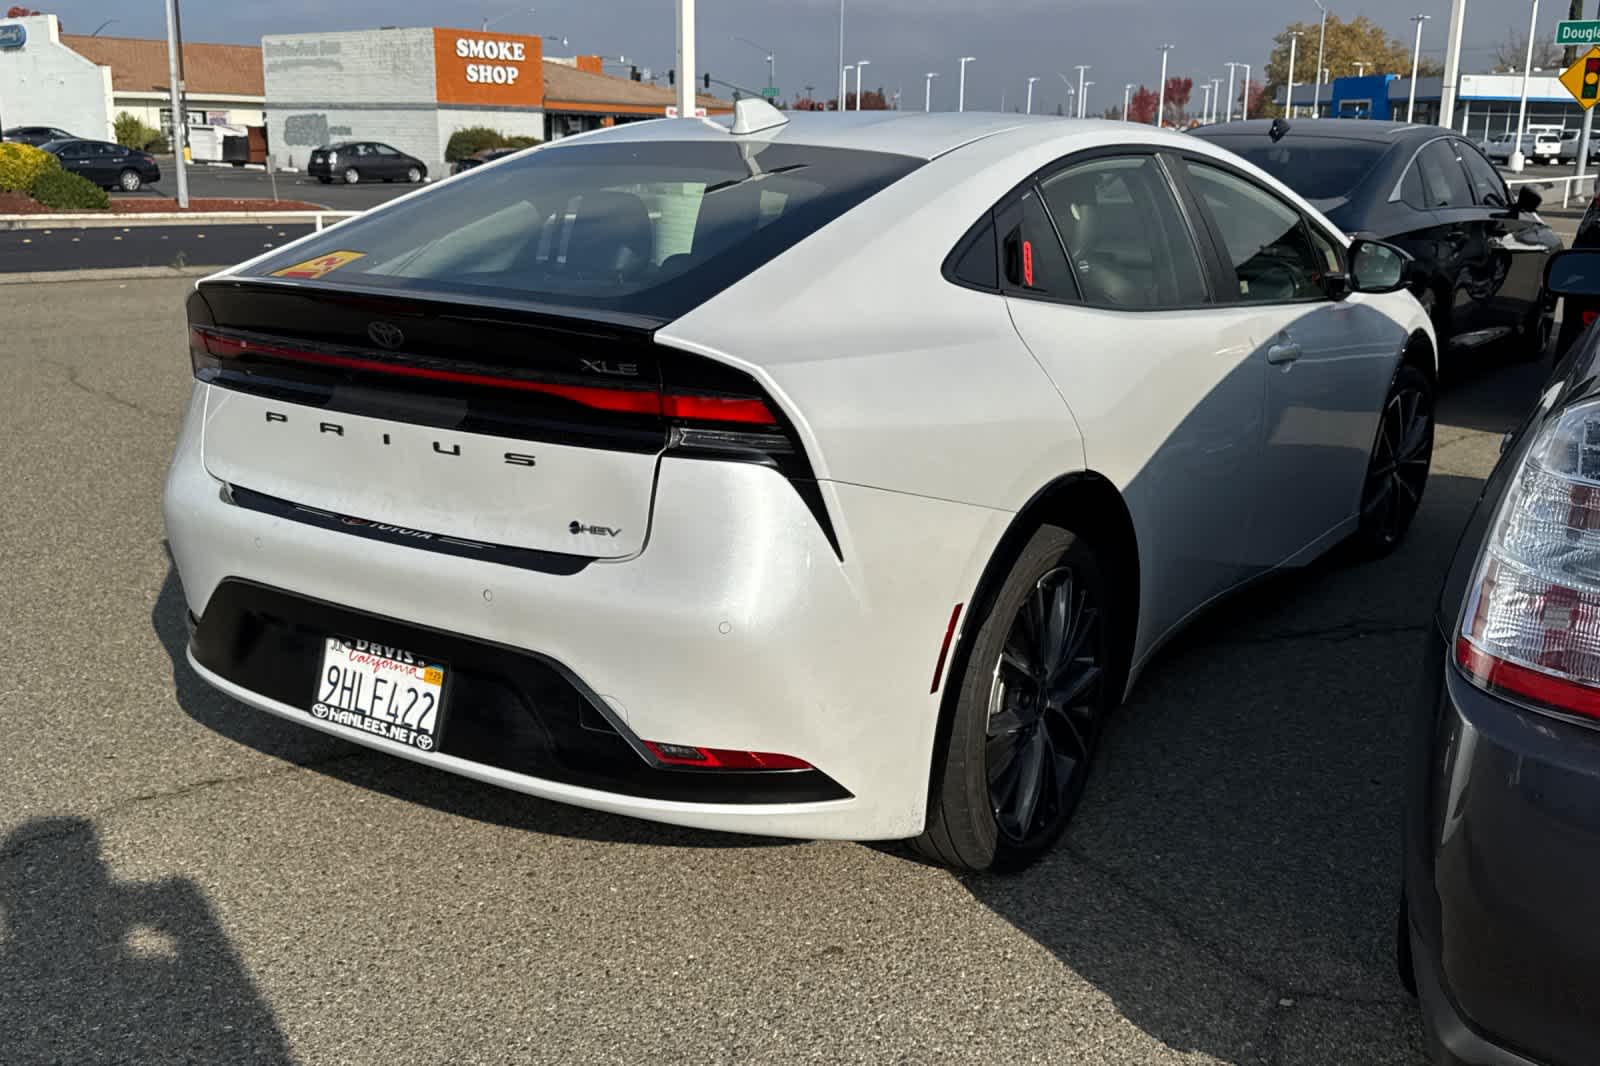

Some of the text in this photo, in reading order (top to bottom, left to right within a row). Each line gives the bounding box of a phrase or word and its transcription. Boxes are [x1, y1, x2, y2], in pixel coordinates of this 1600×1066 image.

[456, 38, 526, 62] SMOKE
[466, 64, 519, 86] SHOP
[579, 358, 639, 376] XLE
[265, 411, 537, 467] PRIUS
[579, 525, 622, 538] HEV
[355, 639, 416, 664] DAVIS
[325, 665, 435, 734] 9HLF422
[328, 707, 418, 745] HANLEES.NET
